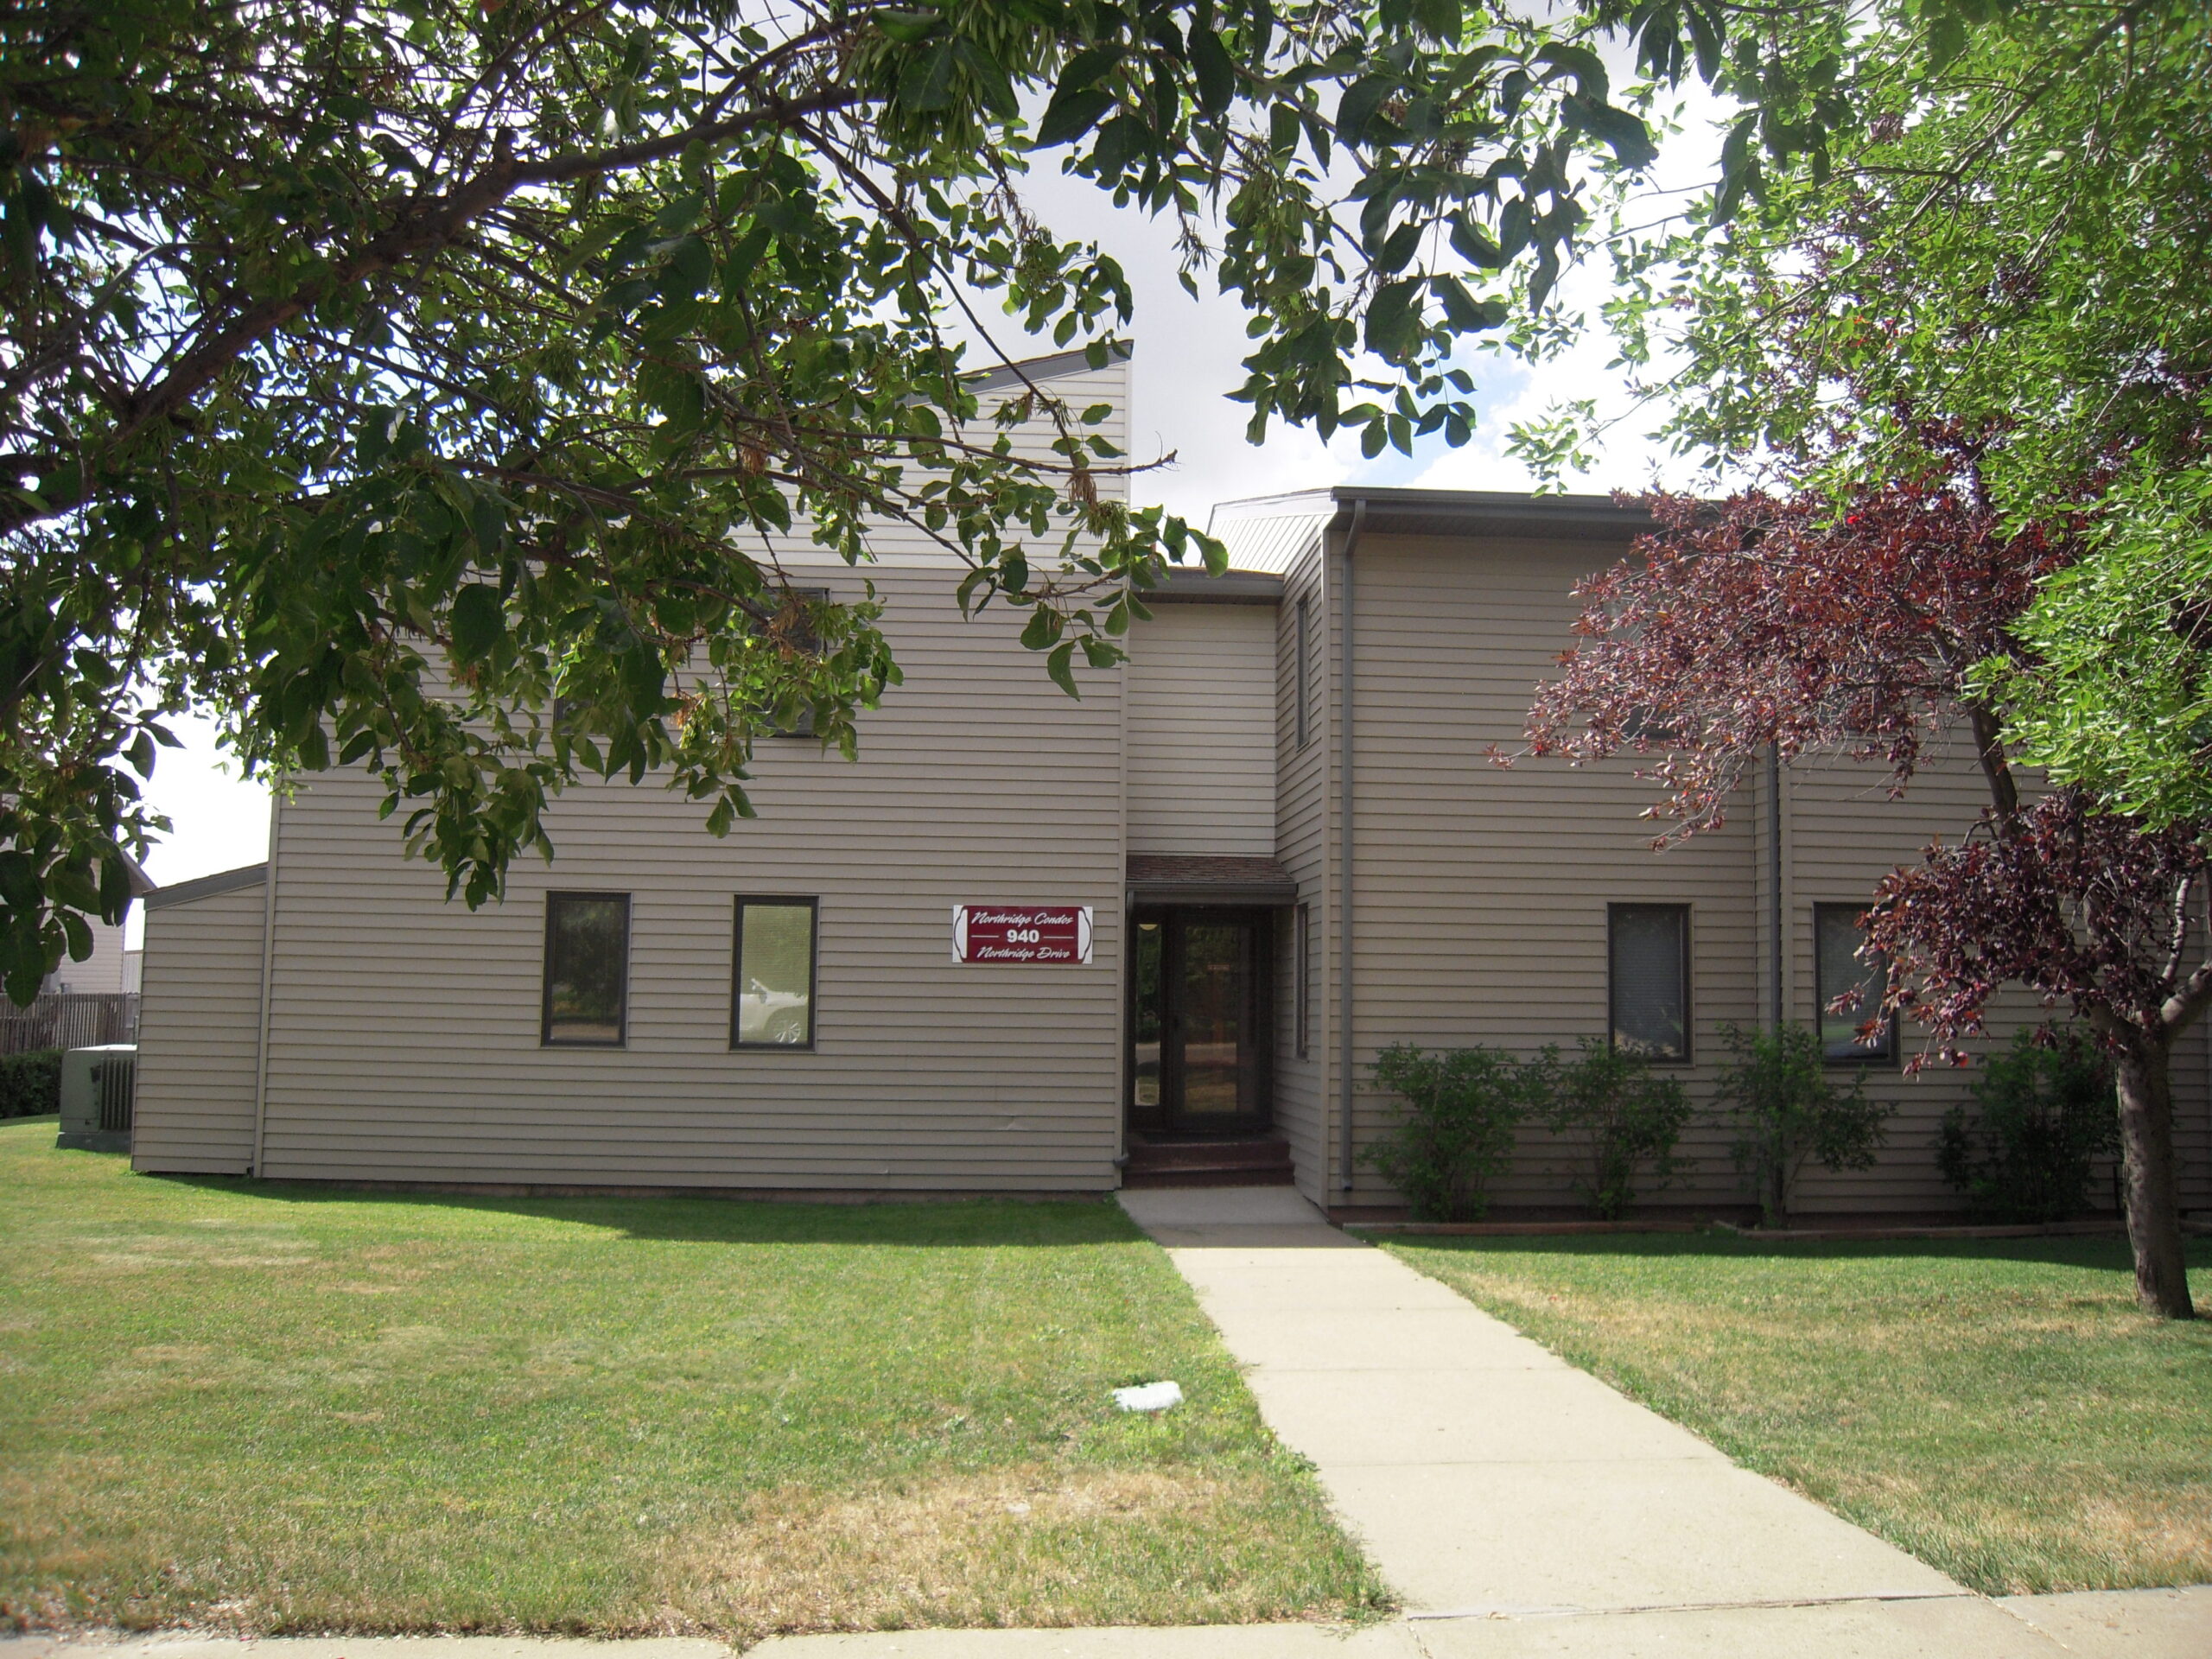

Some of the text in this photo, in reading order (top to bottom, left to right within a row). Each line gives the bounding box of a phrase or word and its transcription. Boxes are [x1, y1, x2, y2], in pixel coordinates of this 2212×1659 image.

[971, 912, 1074, 927] Northridge Condos
[1007, 930, 1040, 944] 940
[977, 946, 1071, 962] Northridge Drive
